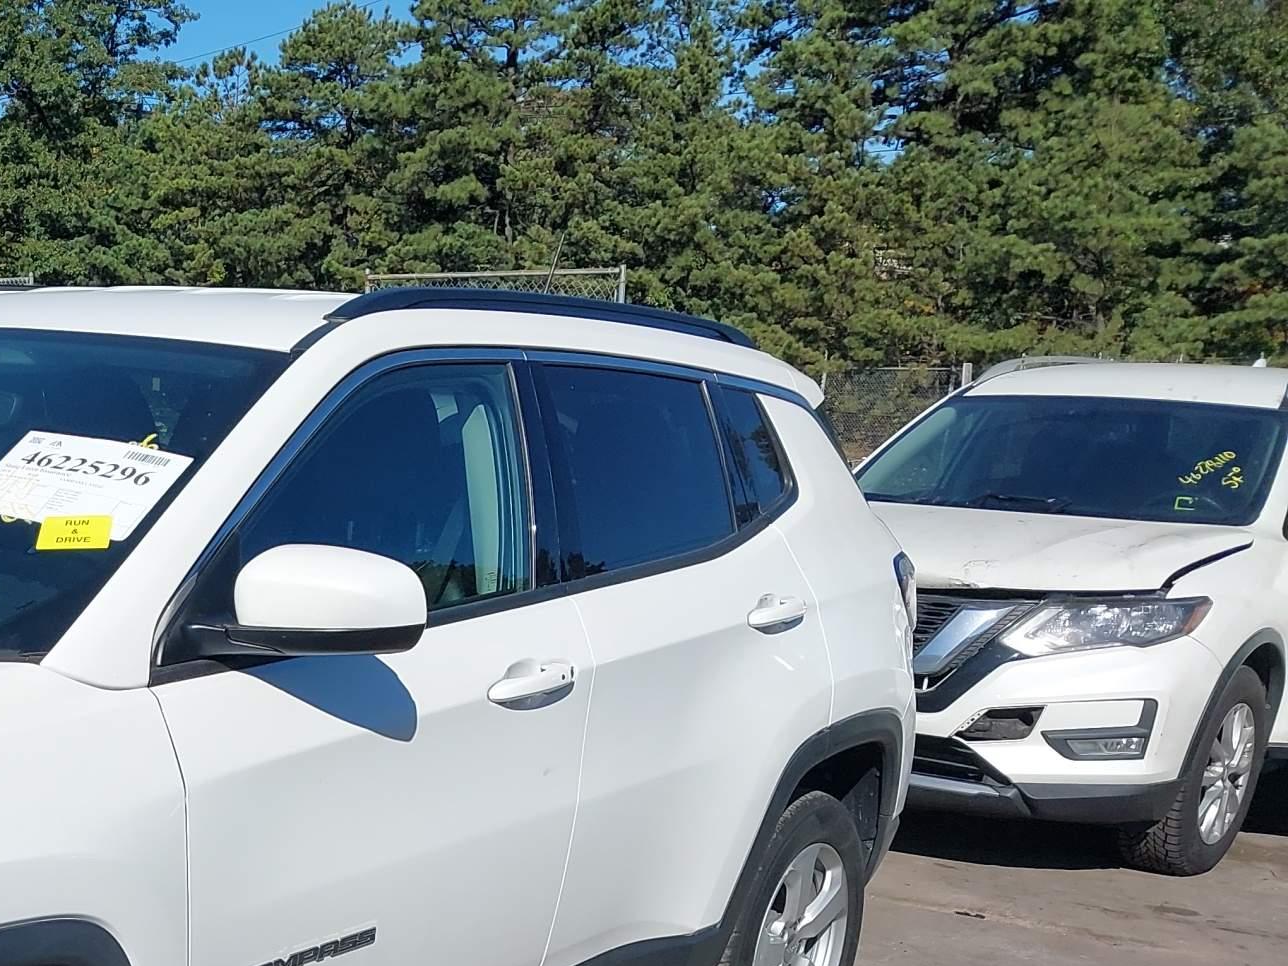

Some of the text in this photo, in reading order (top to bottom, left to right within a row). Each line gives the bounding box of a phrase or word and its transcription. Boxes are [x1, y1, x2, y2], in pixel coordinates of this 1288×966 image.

[20, 450, 157, 486] 46225296
[64, 519, 90, 527] RUN
[55, 536, 92, 544] DRIVE
